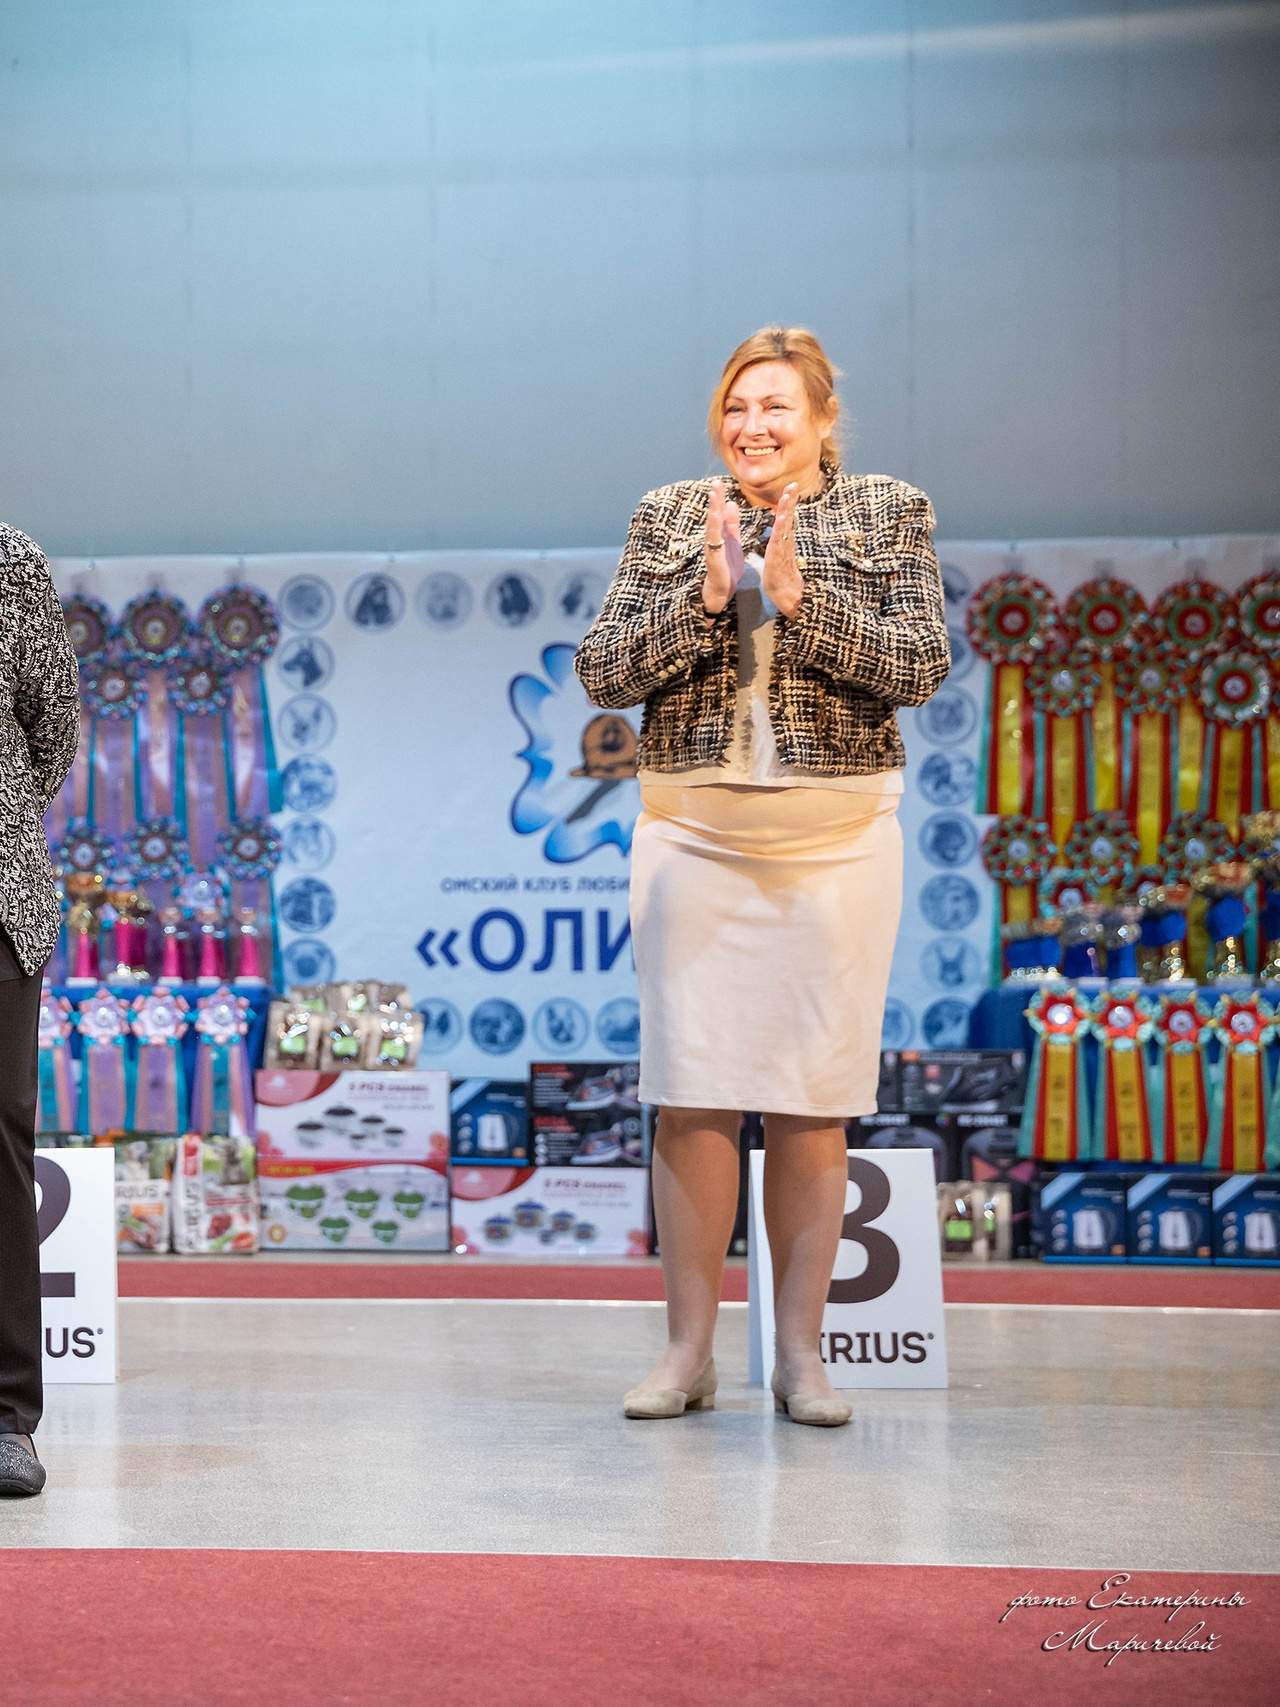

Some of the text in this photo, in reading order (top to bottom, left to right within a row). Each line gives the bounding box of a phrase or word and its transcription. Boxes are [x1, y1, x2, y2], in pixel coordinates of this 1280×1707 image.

[440, 875, 518, 893] ОМСКИЙ
[523, 877, 571, 892] КЛУБ
[825, 1155, 901, 1304] 3
